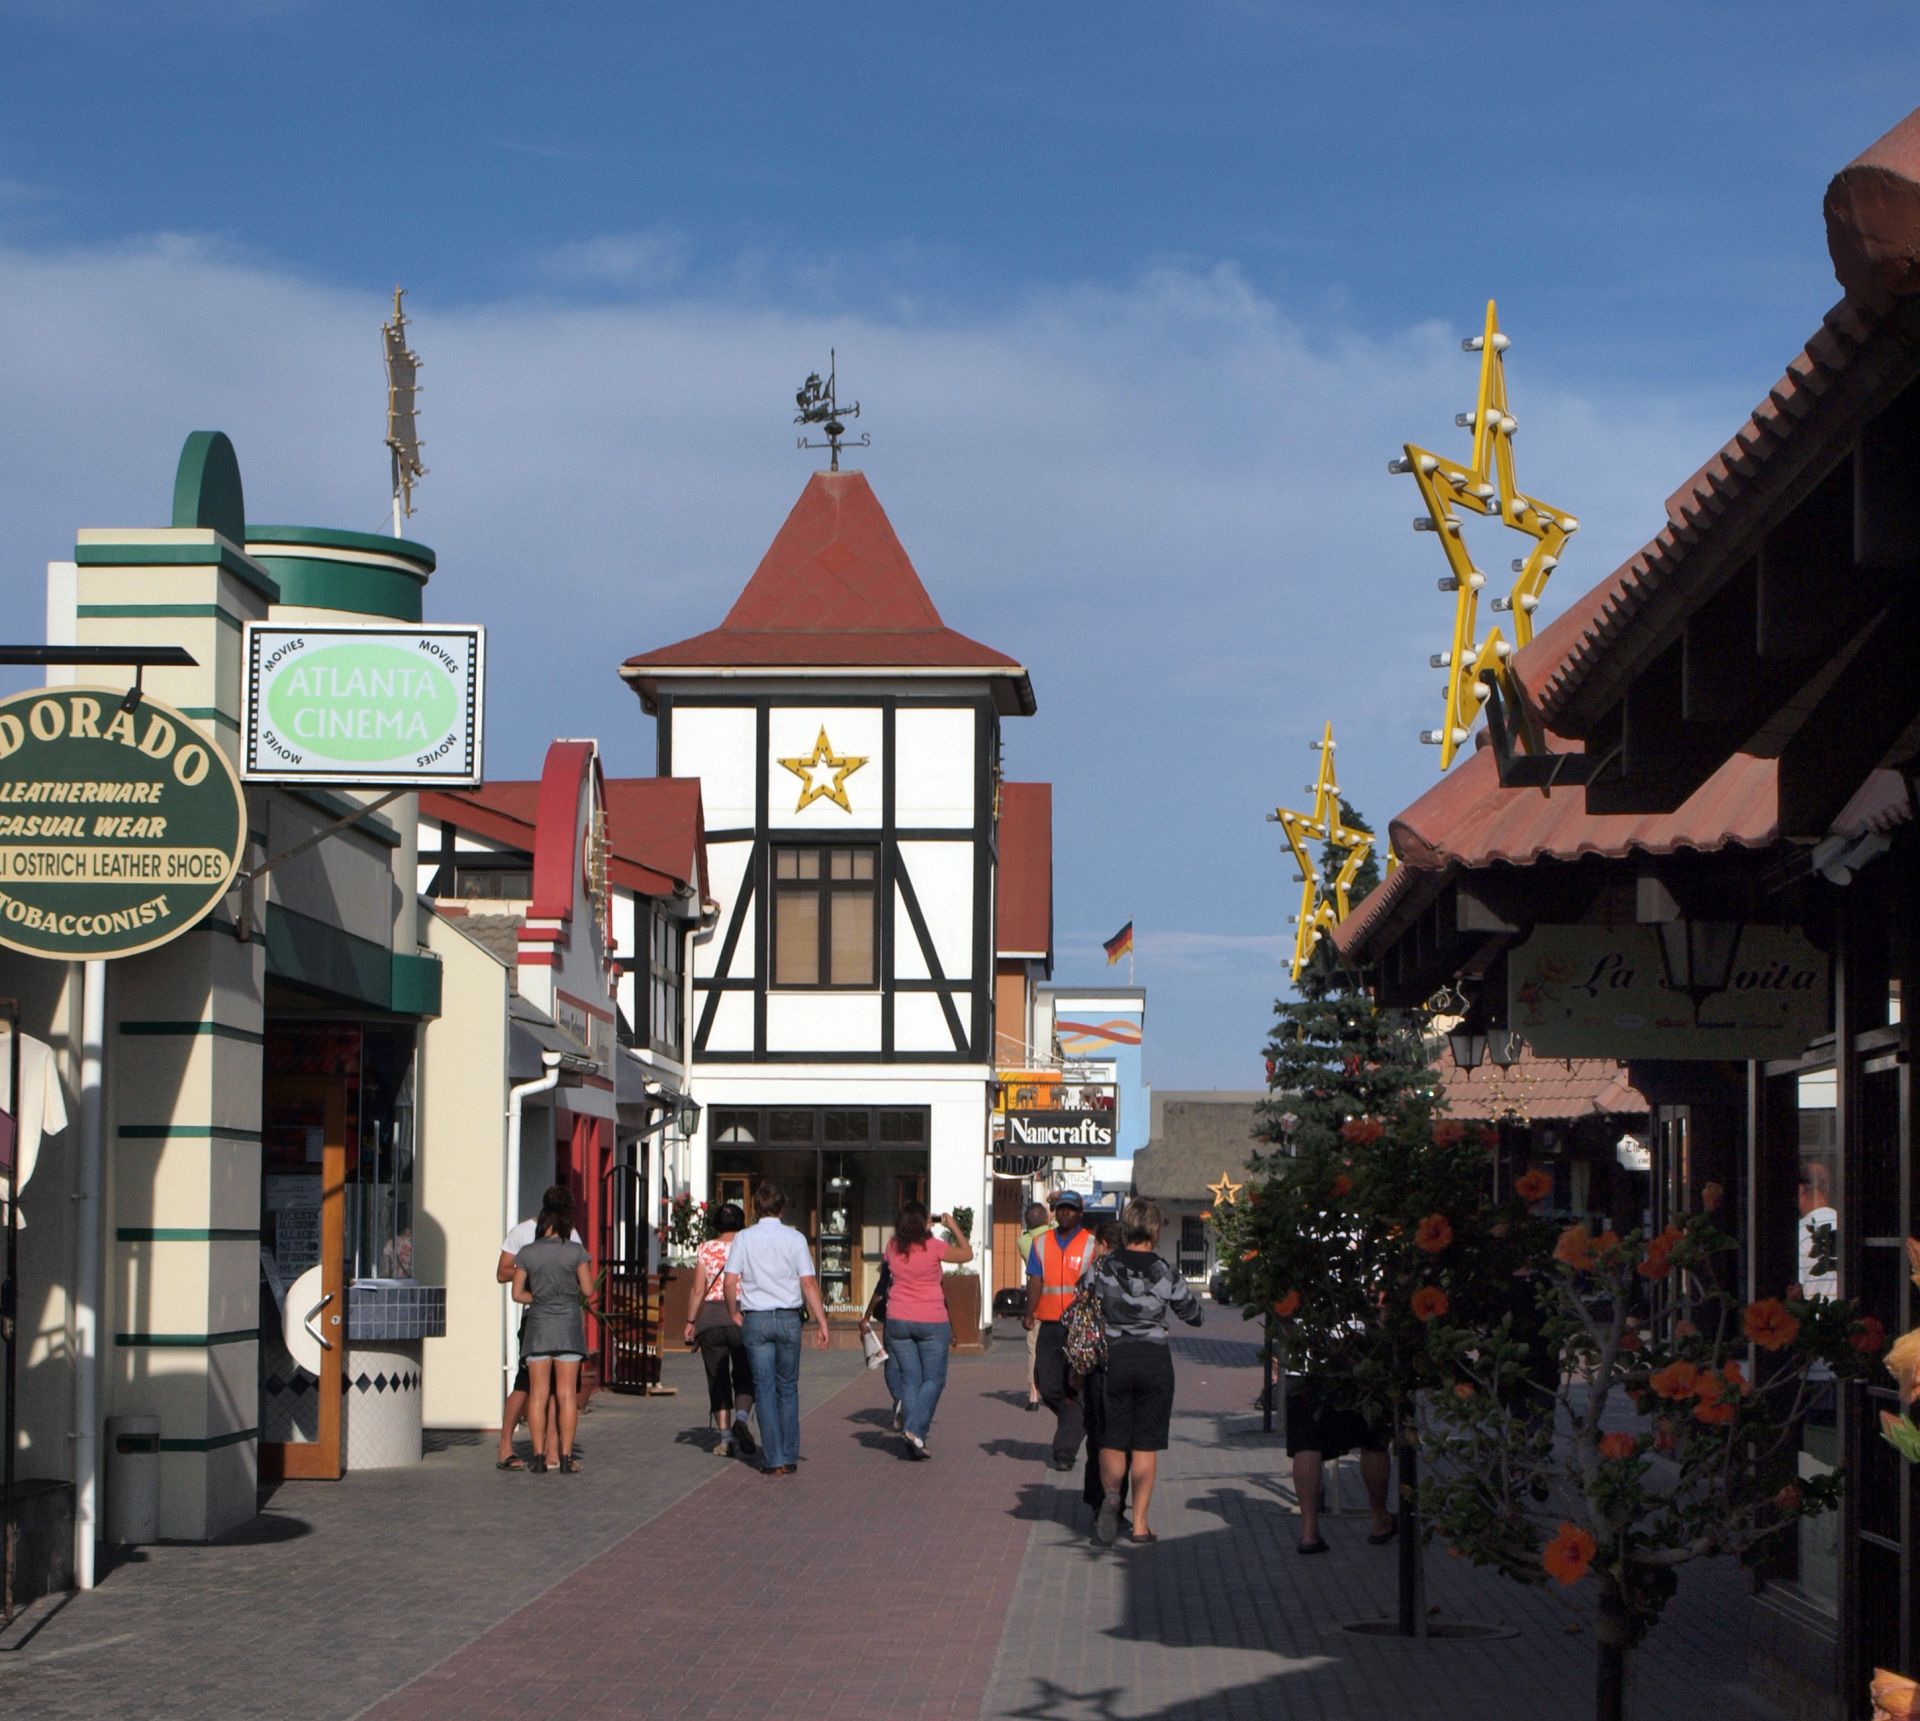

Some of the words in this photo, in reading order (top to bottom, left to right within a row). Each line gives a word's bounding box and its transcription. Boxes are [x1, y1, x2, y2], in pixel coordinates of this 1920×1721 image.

[264, 638, 305, 672] MOVIES
[418, 639, 459, 674] MOVIES
[287, 667, 437, 699] ATLANTA
[293, 707, 430, 740] CINEMA
[0, 697, 210, 786] DORADO
[262, 730, 303, 765] MOVIES
[416, 733, 457, 767] MOVIES
[0, 782, 164, 803] LEATHERWARE
[0, 815, 85, 837] CASUAL
[93, 816, 168, 838] WEAR
[13, 852, 86, 876] OSTRICH
[93, 853, 161, 878] LEATHER
[167, 854, 222, 878] SHOES
[1571, 953, 1635, 998] La
[1009, 1117, 1112, 1145] Namcrafts
